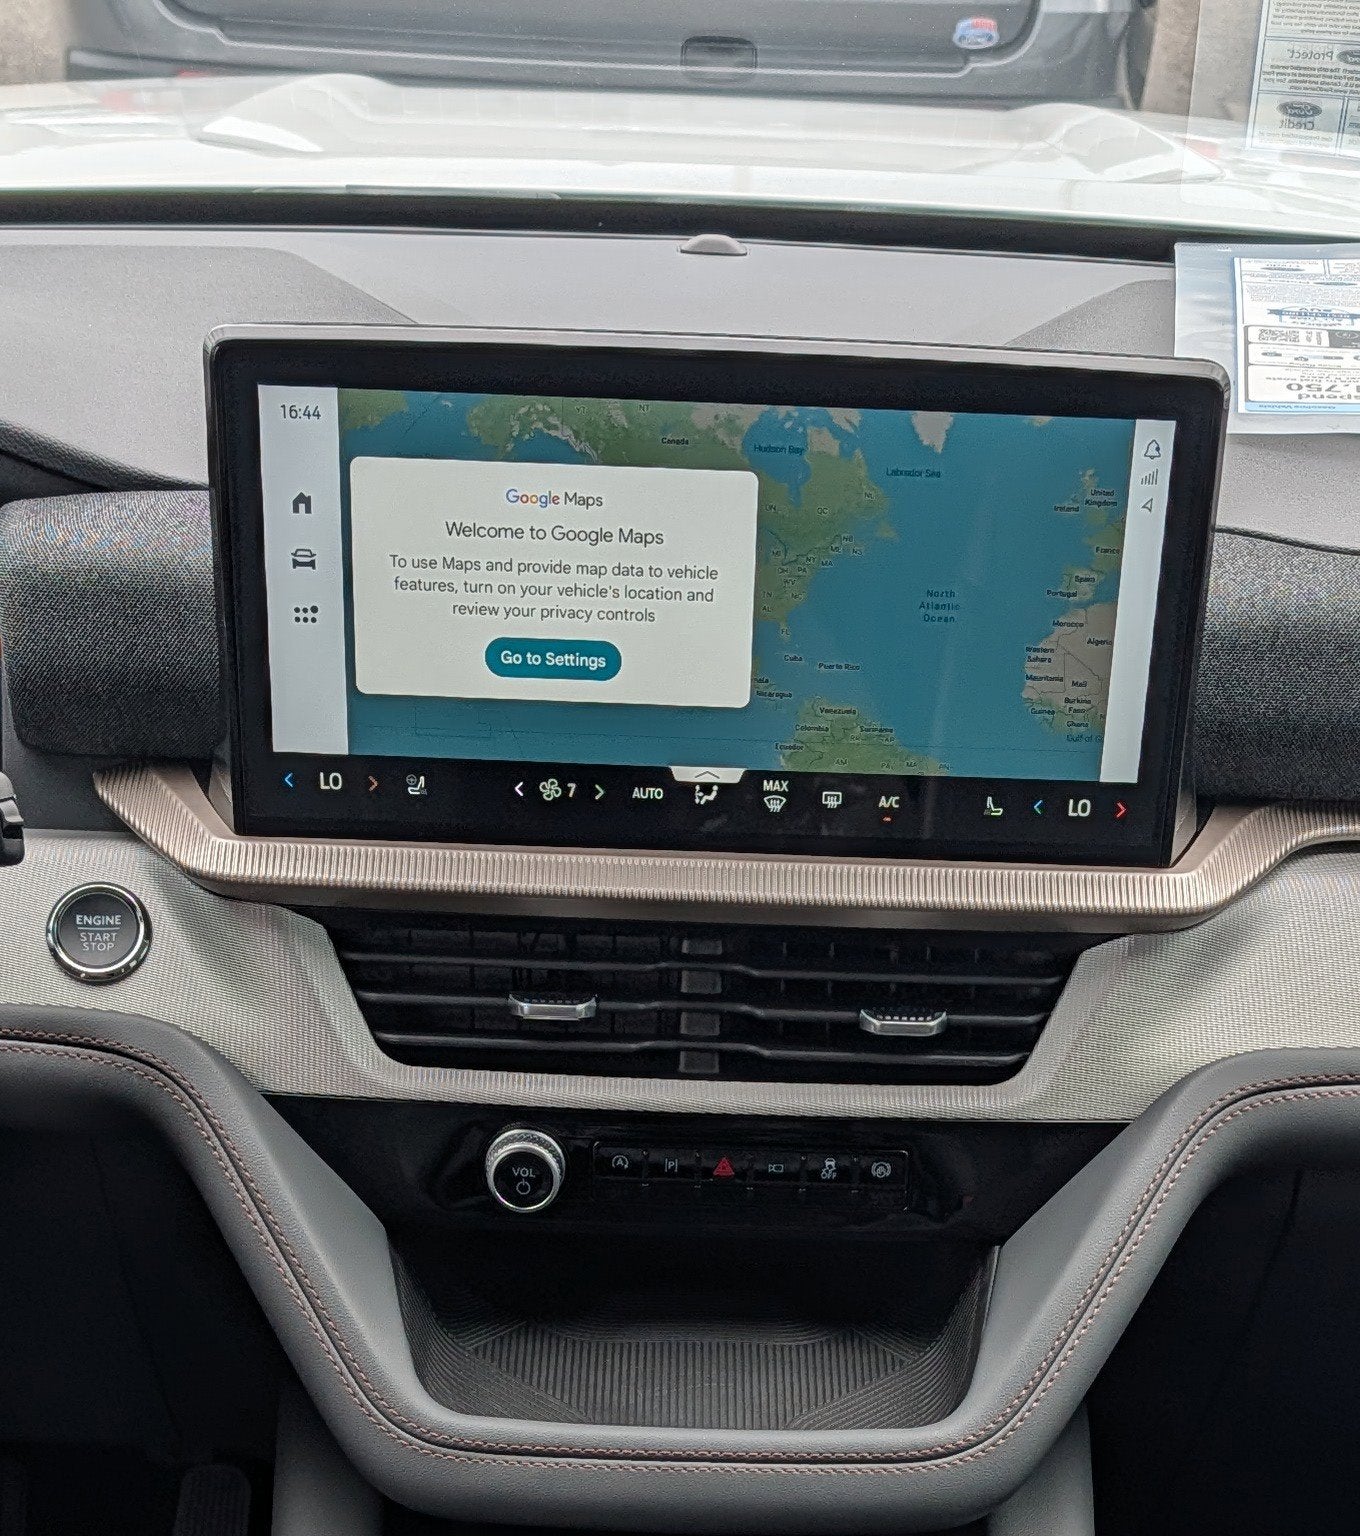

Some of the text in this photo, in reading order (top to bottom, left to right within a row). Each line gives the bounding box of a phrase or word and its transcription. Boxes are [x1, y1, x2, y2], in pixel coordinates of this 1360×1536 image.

[280, 404, 322, 420] 16:44
[661, 437, 689, 446] Canada
[506, 488, 603, 510] Google Maps
[445, 521, 664, 548] Welcome to Google Maps
[389, 554, 719, 580] To use Maps and provide map data to vehicle
[394, 576, 714, 602] features, turn on your vehicle's location and
[926, 589, 956, 598] North
[452, 602, 656, 623] review your privacy controls
[919, 601, 960, 611] Atlantic
[923, 613, 955, 623] Ocean
[500, 651, 606, 671] Go to Settings
[319, 772, 342, 791] LO
[763, 780, 789, 793] MAX
[567, 783, 576, 798] 7
[632, 787, 664, 800] AUTO
[879, 795, 900, 809] A/C
[1068, 799, 1091, 818] LO
[75, 914, 122, 925] ENGINE
[80, 932, 117, 942] START
[82, 943, 115, 951] STOP
[512, 1167, 536, 1179] VOL
[821, 1171, 837, 1180] OFF
